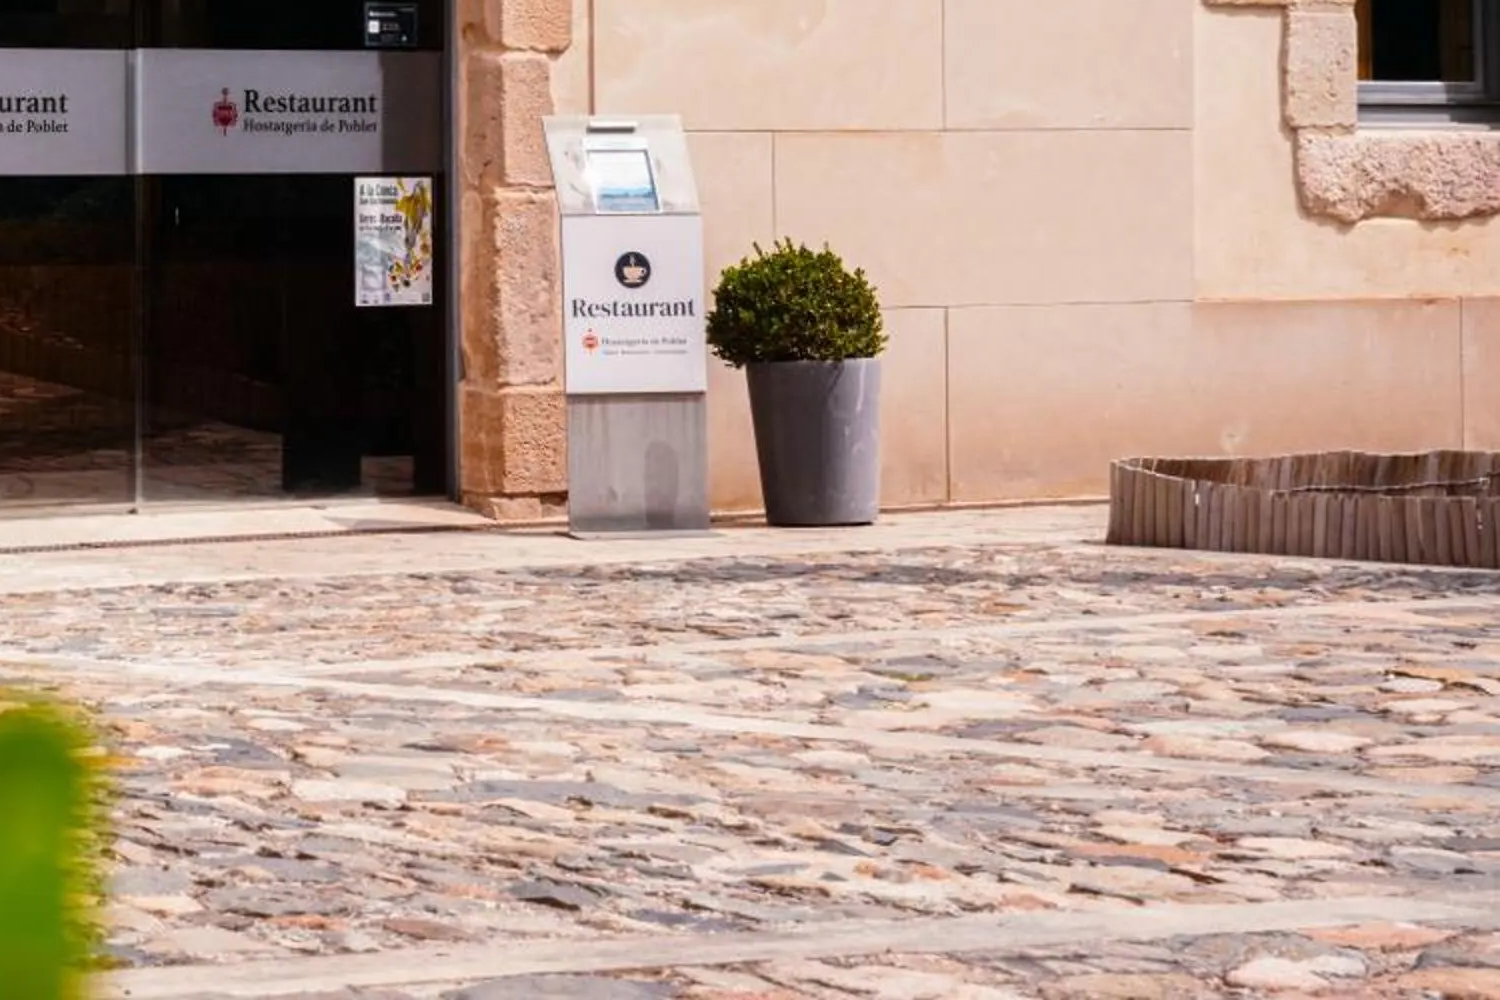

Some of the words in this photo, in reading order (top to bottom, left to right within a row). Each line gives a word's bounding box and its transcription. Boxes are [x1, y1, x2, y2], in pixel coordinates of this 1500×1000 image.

[243, 89, 377, 114] Restaurant
[7, 118, 23, 134] de
[26, 119, 68, 133] Poblet
[243, 118, 317, 136] Hostatgeria
[320, 119, 335, 133] de
[338, 119, 377, 133] Poblet
[572, 299, 695, 318] Restaurant
